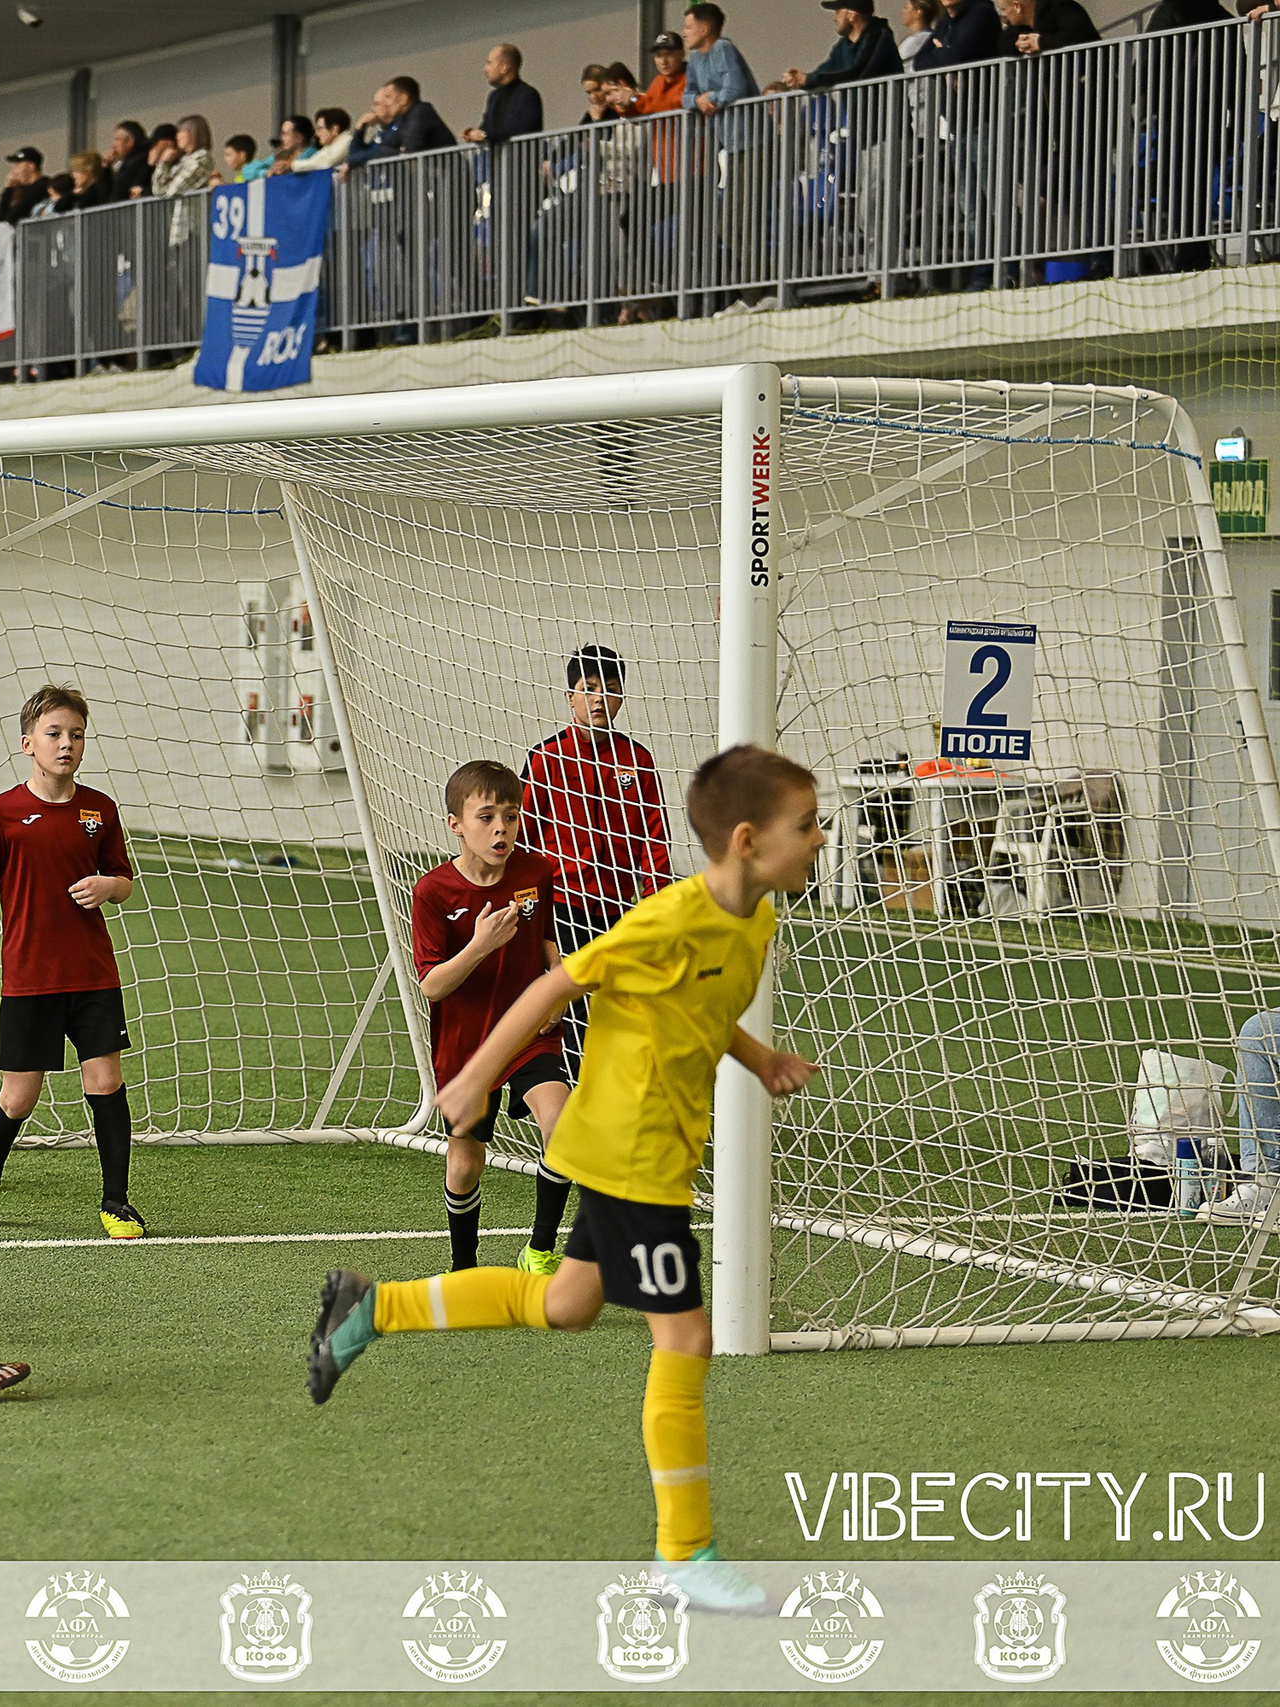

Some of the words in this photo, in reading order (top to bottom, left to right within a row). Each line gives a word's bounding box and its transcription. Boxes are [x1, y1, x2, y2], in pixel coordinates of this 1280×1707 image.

[212, 195, 245, 240] 39
[751, 433, 770, 587] SPORTWERK
[1213, 480, 1264, 517] ВЫХОД
[966, 644, 1012, 727] 2
[946, 733, 1025, 755] ПОЛЕ
[630, 1242, 687, 1296] 10
